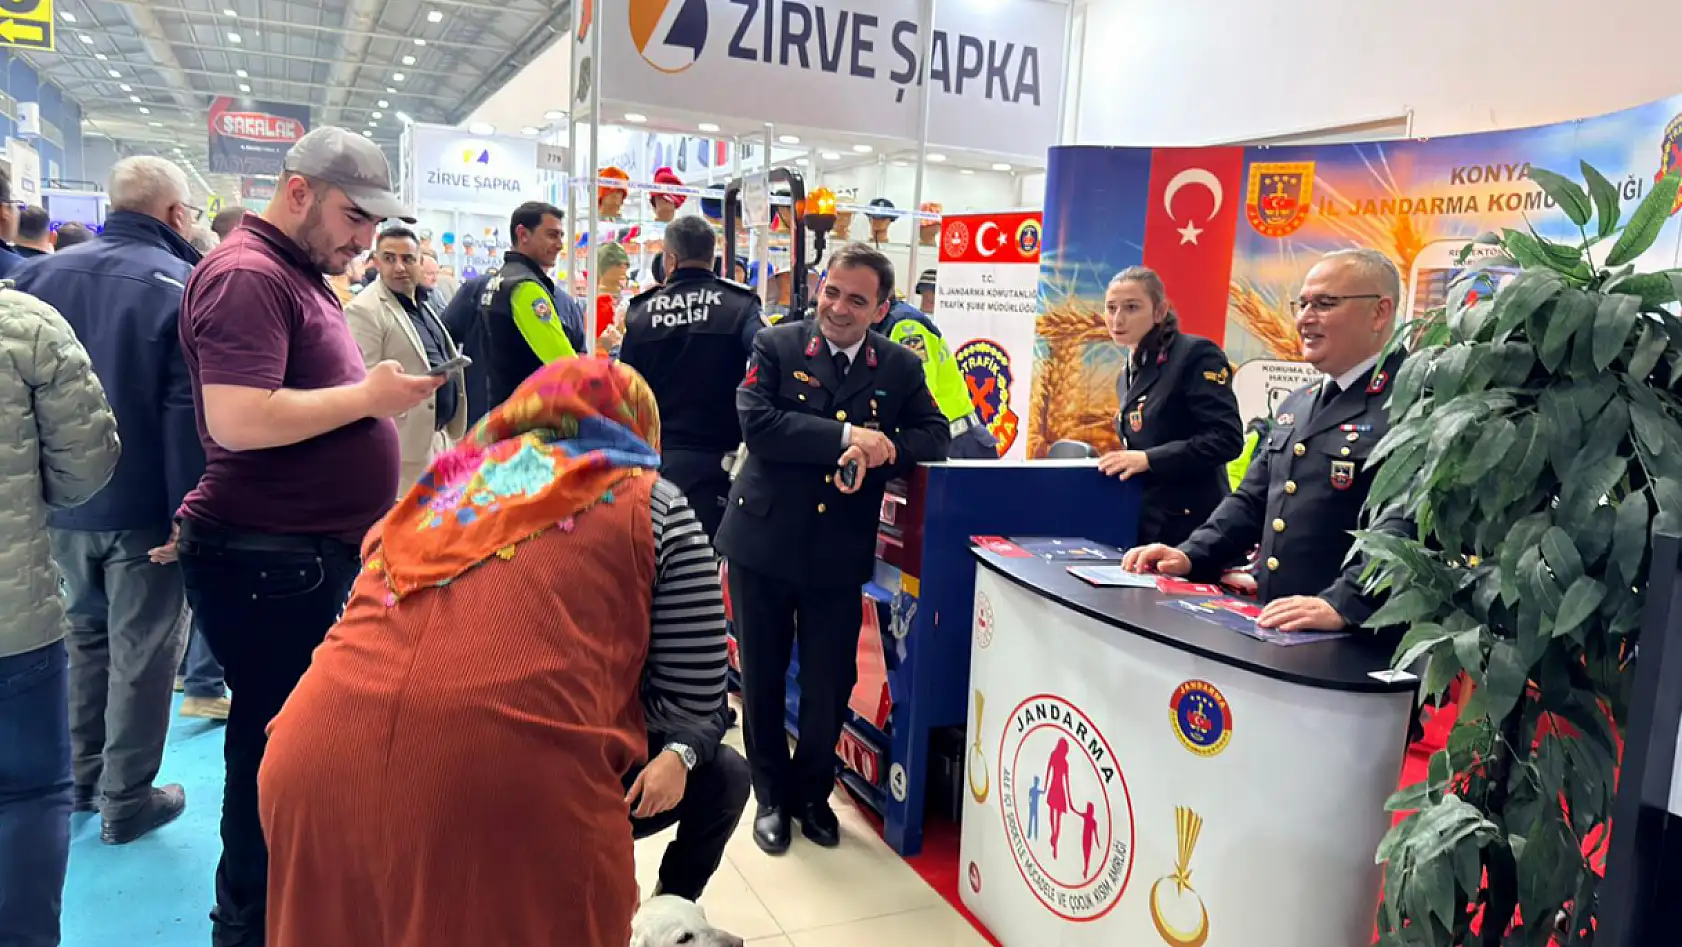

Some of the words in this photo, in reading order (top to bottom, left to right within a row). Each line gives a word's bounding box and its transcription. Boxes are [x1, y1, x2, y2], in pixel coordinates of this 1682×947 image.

[889, 20, 1041, 106] ŞAPKA
[427, 168, 470, 187] ZİRVE
[473, 176, 521, 193] ŞAPKA
[1451, 162, 1532, 185] KONYA
[1348, 195, 1479, 215] JANDARMA
[1488, 174, 1642, 212] KOMUIĞI
[1017, 703, 1114, 784] JANDARMA
